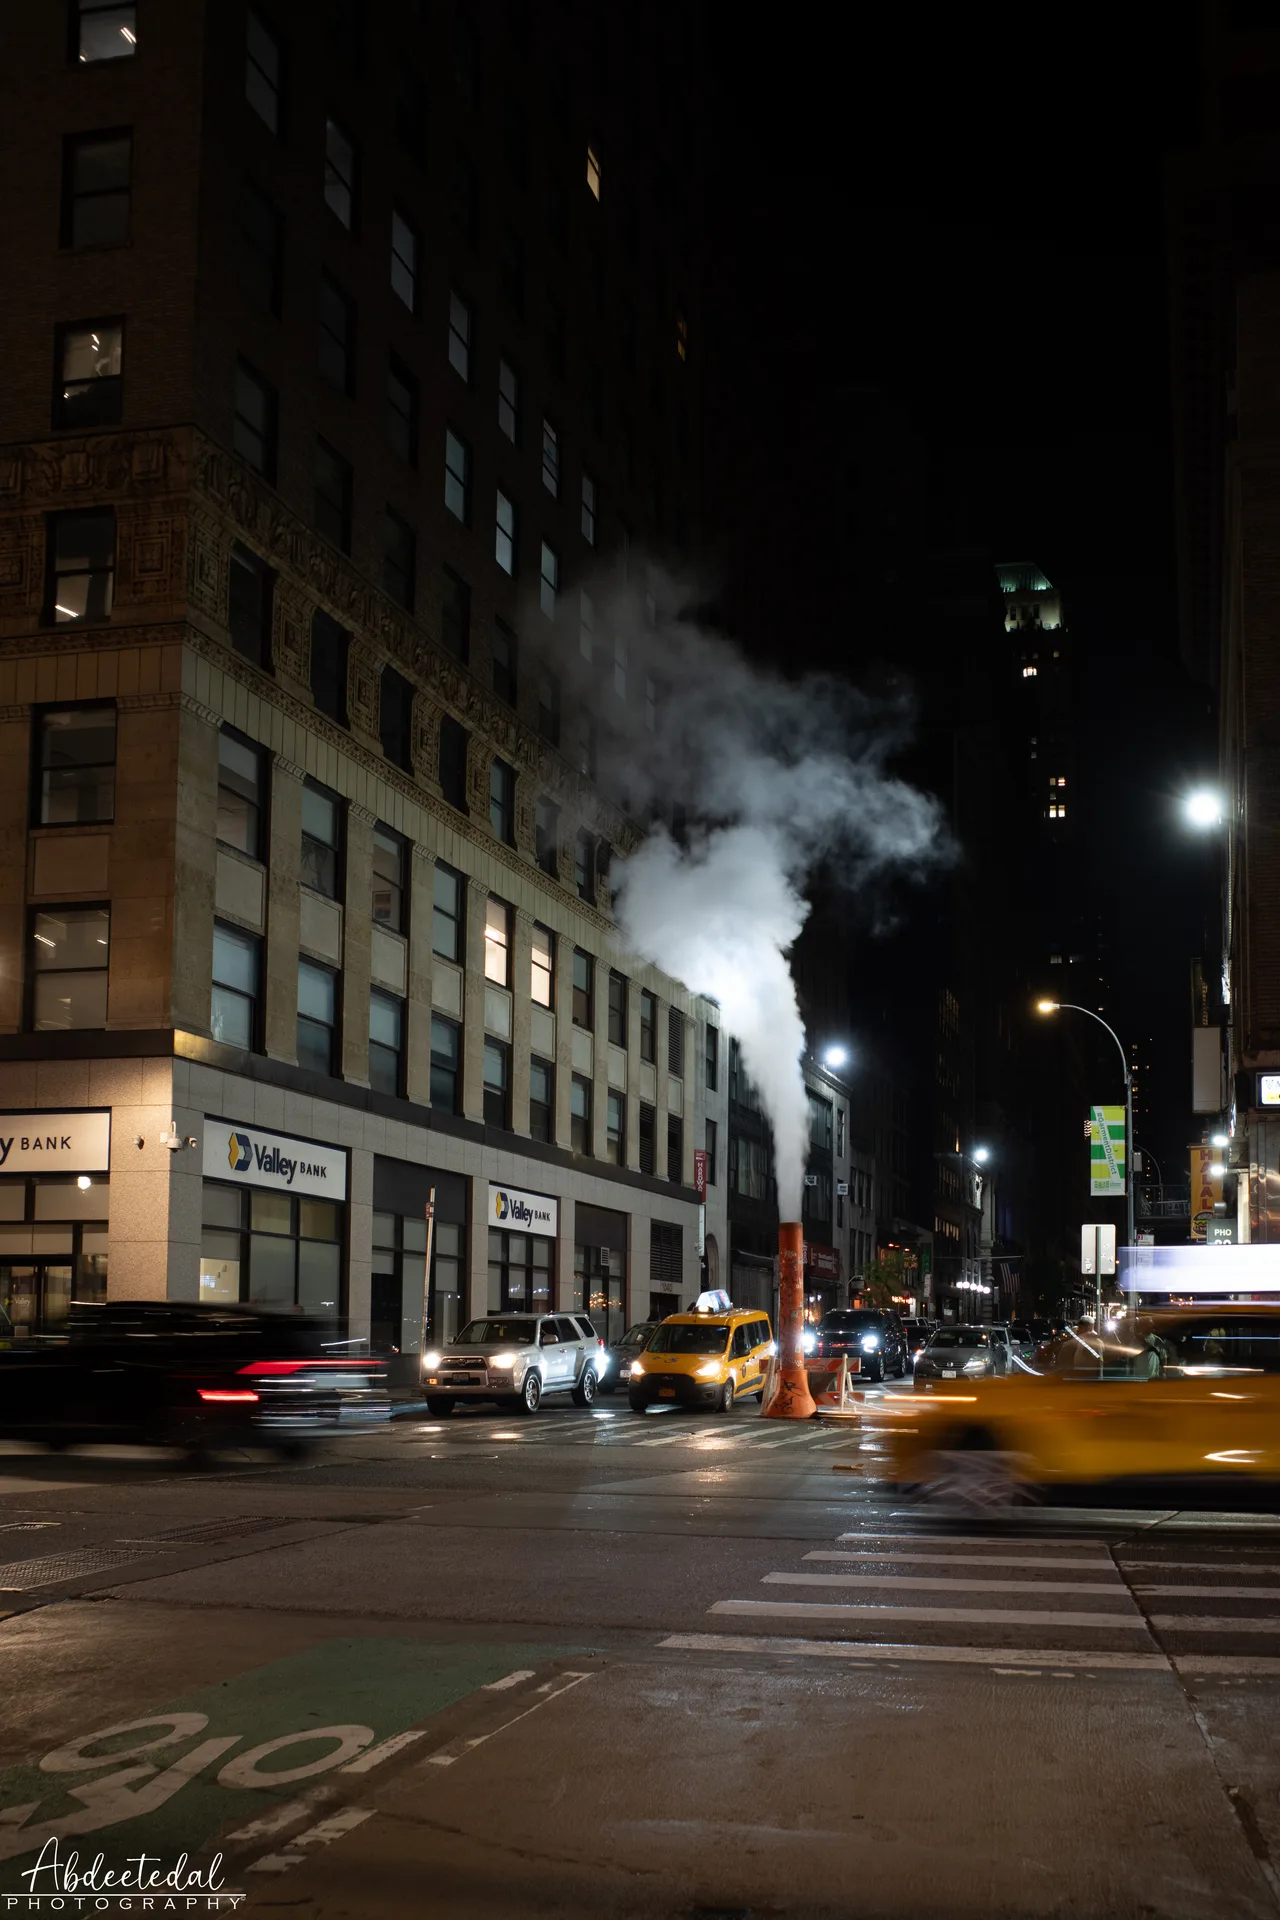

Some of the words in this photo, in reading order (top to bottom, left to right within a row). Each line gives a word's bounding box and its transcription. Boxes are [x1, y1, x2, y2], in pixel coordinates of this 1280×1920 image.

[21, 1136, 71, 1150] BANK
[1097, 1112, 1117, 1175] #GarmentDistrict
[254, 1143, 297, 1184] Valley
[300, 1162, 327, 1178] BANK
[1200, 1149, 1213, 1210] HALAL
[509, 1198, 533, 1228] Valley
[534, 1210, 551, 1221] BANK
[1214, 1228, 1232, 1236] PHO
